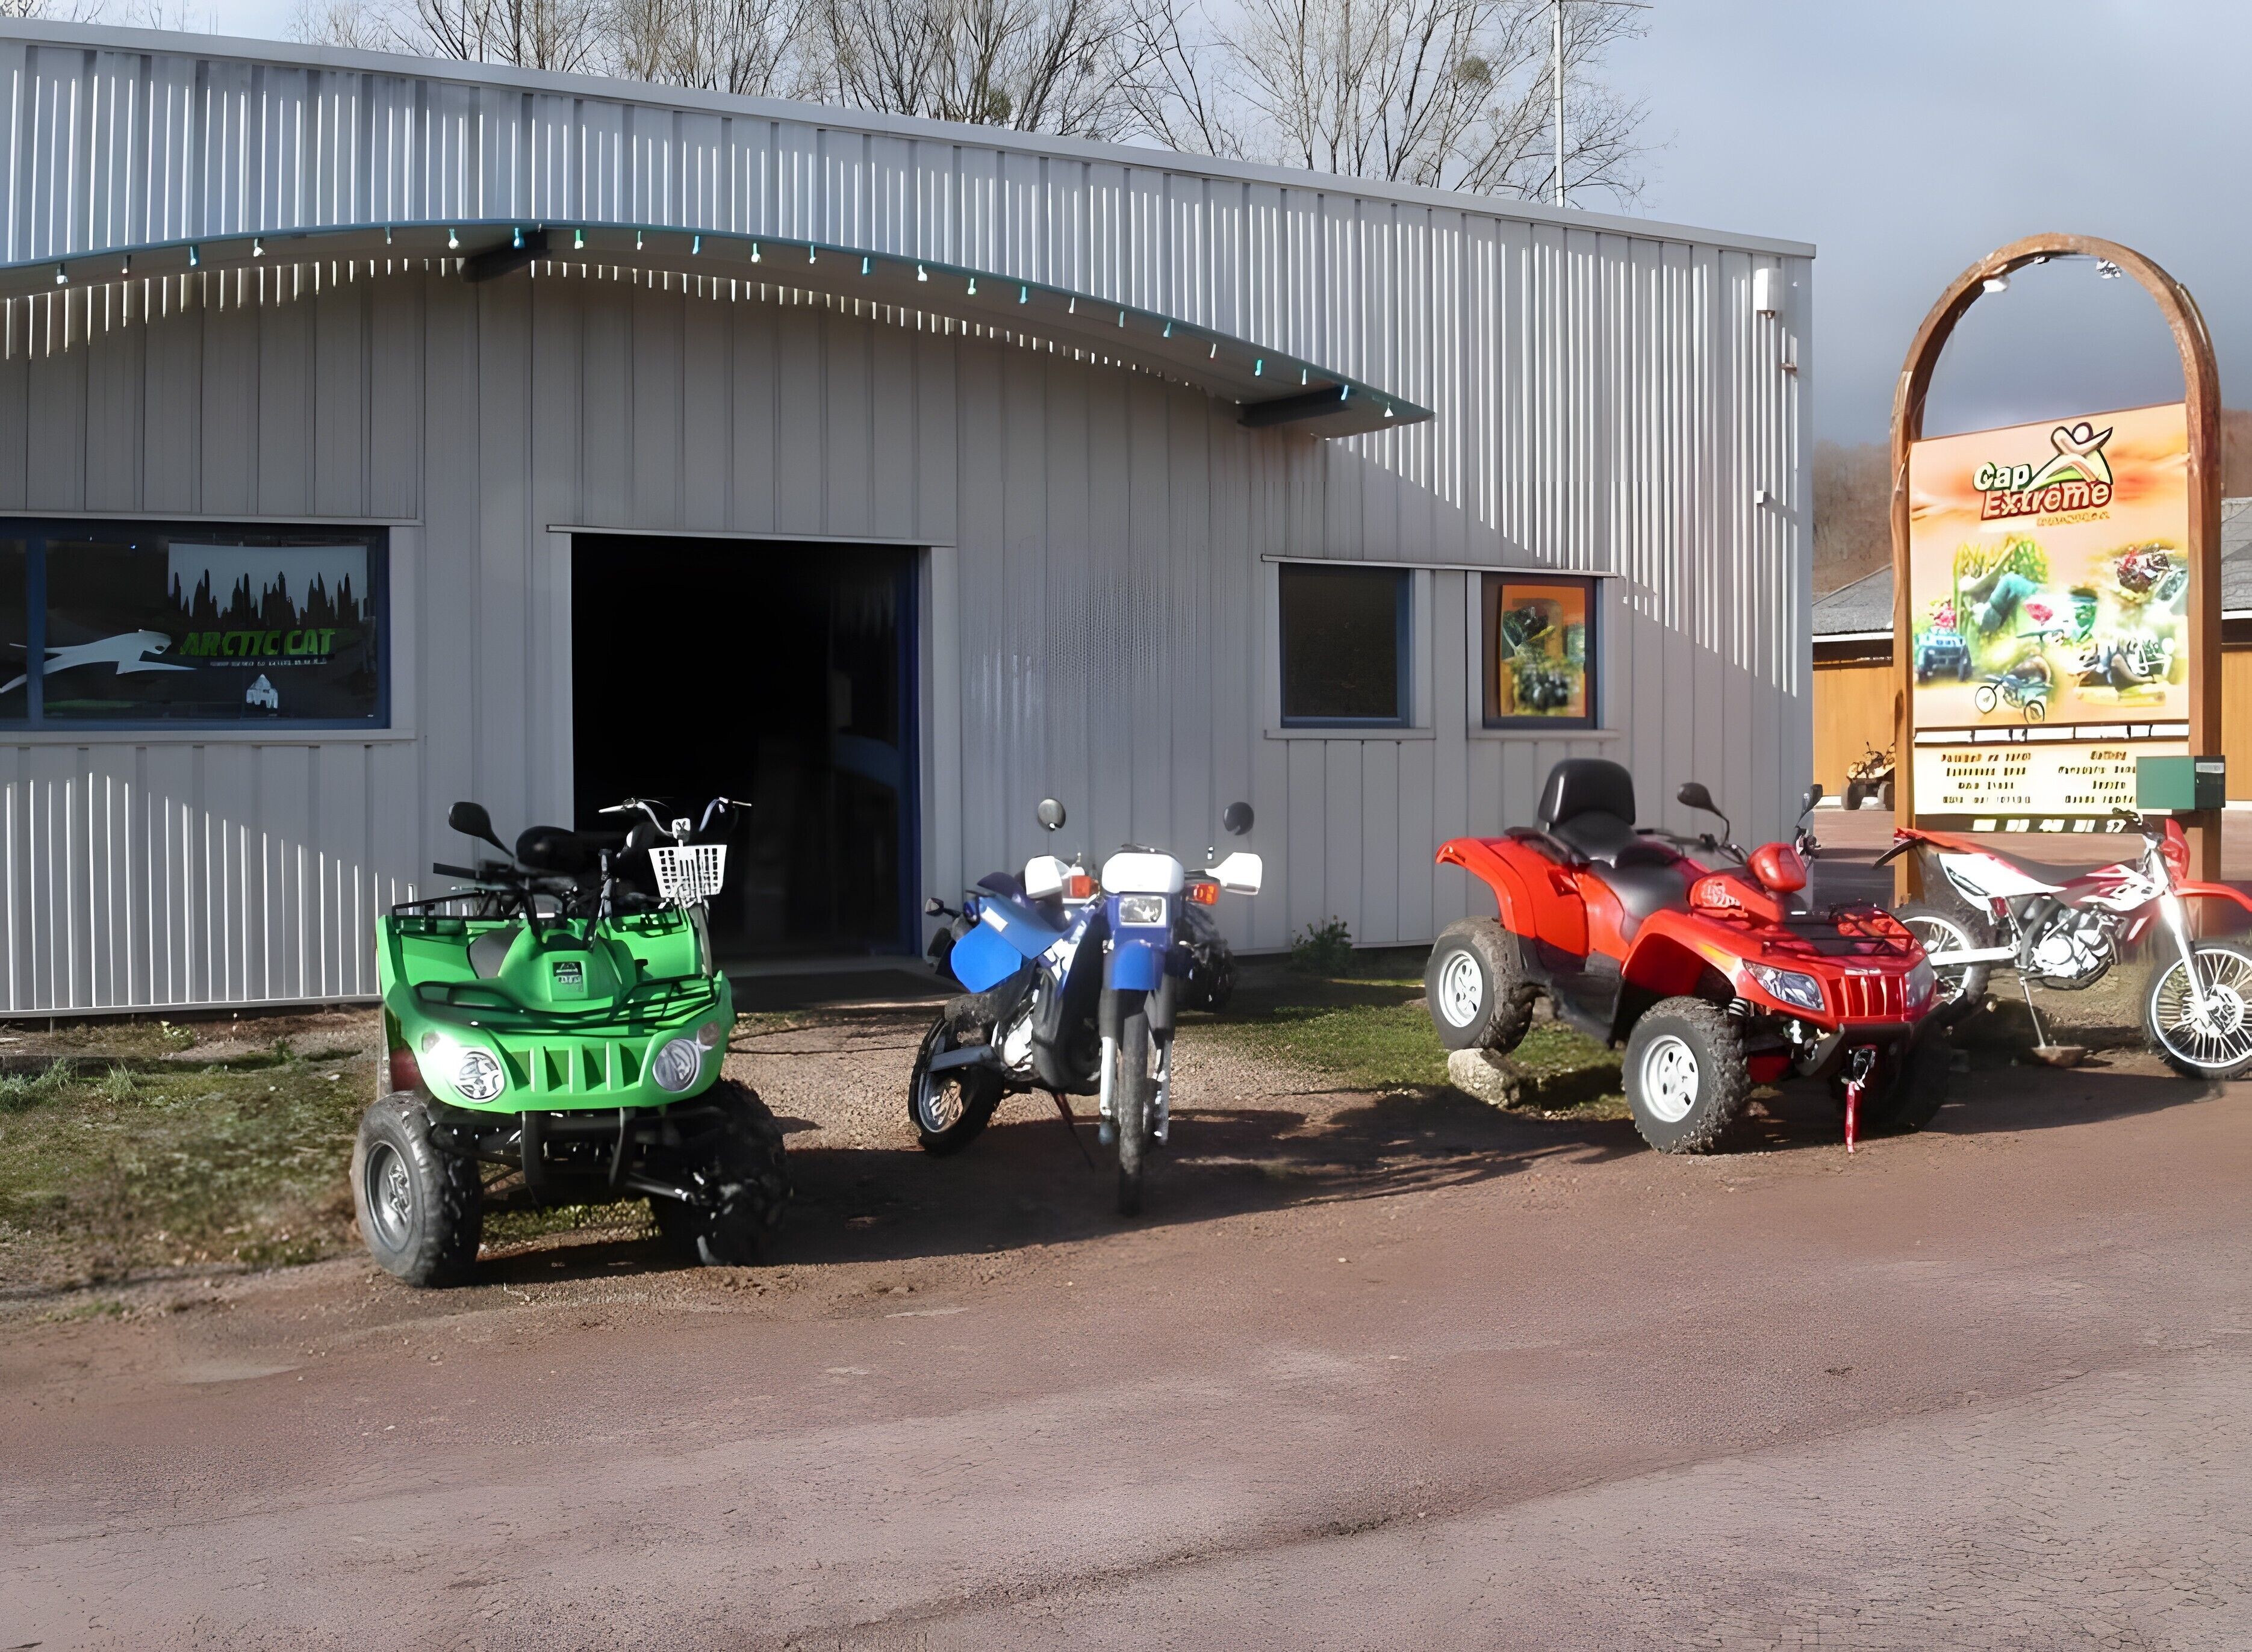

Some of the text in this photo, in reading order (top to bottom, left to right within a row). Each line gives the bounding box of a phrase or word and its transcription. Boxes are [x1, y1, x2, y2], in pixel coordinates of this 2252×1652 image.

[1973, 462, 2033, 491] Cap
[179, 628, 336, 656] ARCTIC CAT
